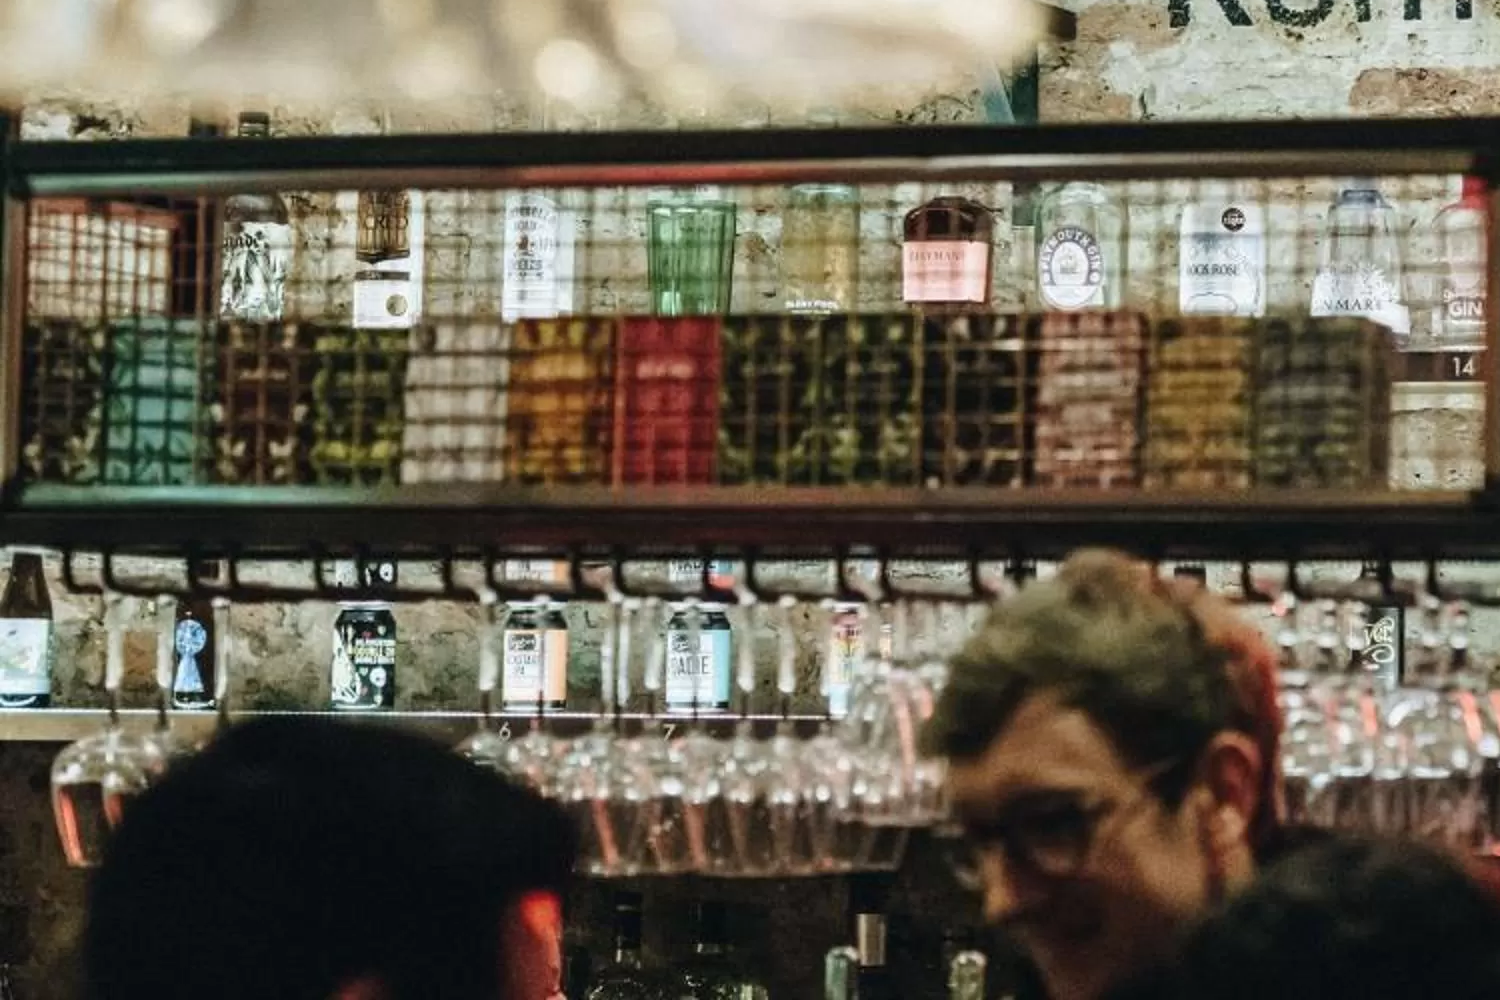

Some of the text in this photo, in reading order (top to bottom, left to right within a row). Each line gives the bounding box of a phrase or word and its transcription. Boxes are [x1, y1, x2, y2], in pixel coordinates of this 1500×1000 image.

[1448, 300, 1483, 318] GIN
[1453, 356, 1476, 377] 14
[499, 721, 511, 741] 6
[663, 723, 676, 741] 7
